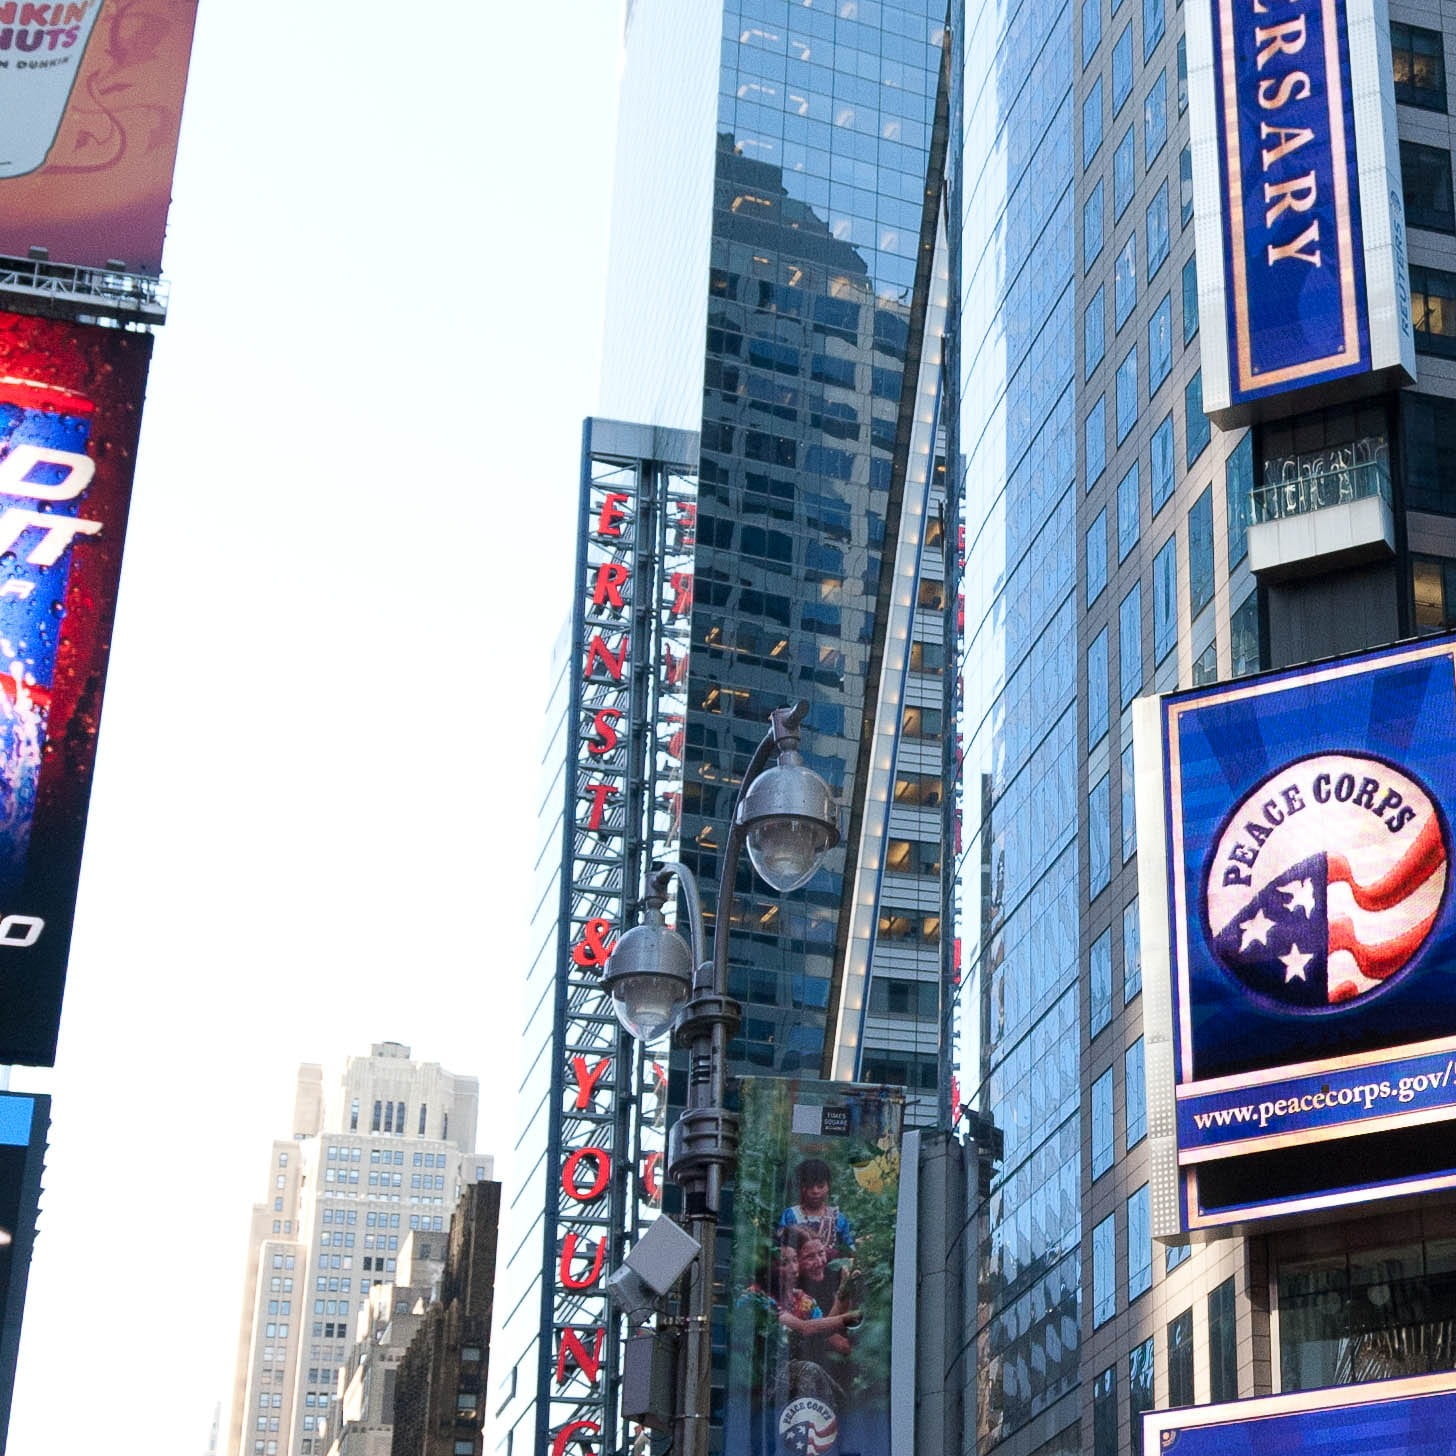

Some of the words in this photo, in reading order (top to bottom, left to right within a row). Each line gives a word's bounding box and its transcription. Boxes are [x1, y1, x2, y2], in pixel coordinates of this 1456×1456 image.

[1397, 221, 1411, 339] REUTERS
[583, 492, 628, 831] ERNST
[1223, 782, 1305, 889] PEACE
[1312, 771, 1417, 835] CORPS
[572, 917, 615, 967] &
[783, 1401, 805, 1425] PEACE
[807, 1401, 833, 1420] CORPS
